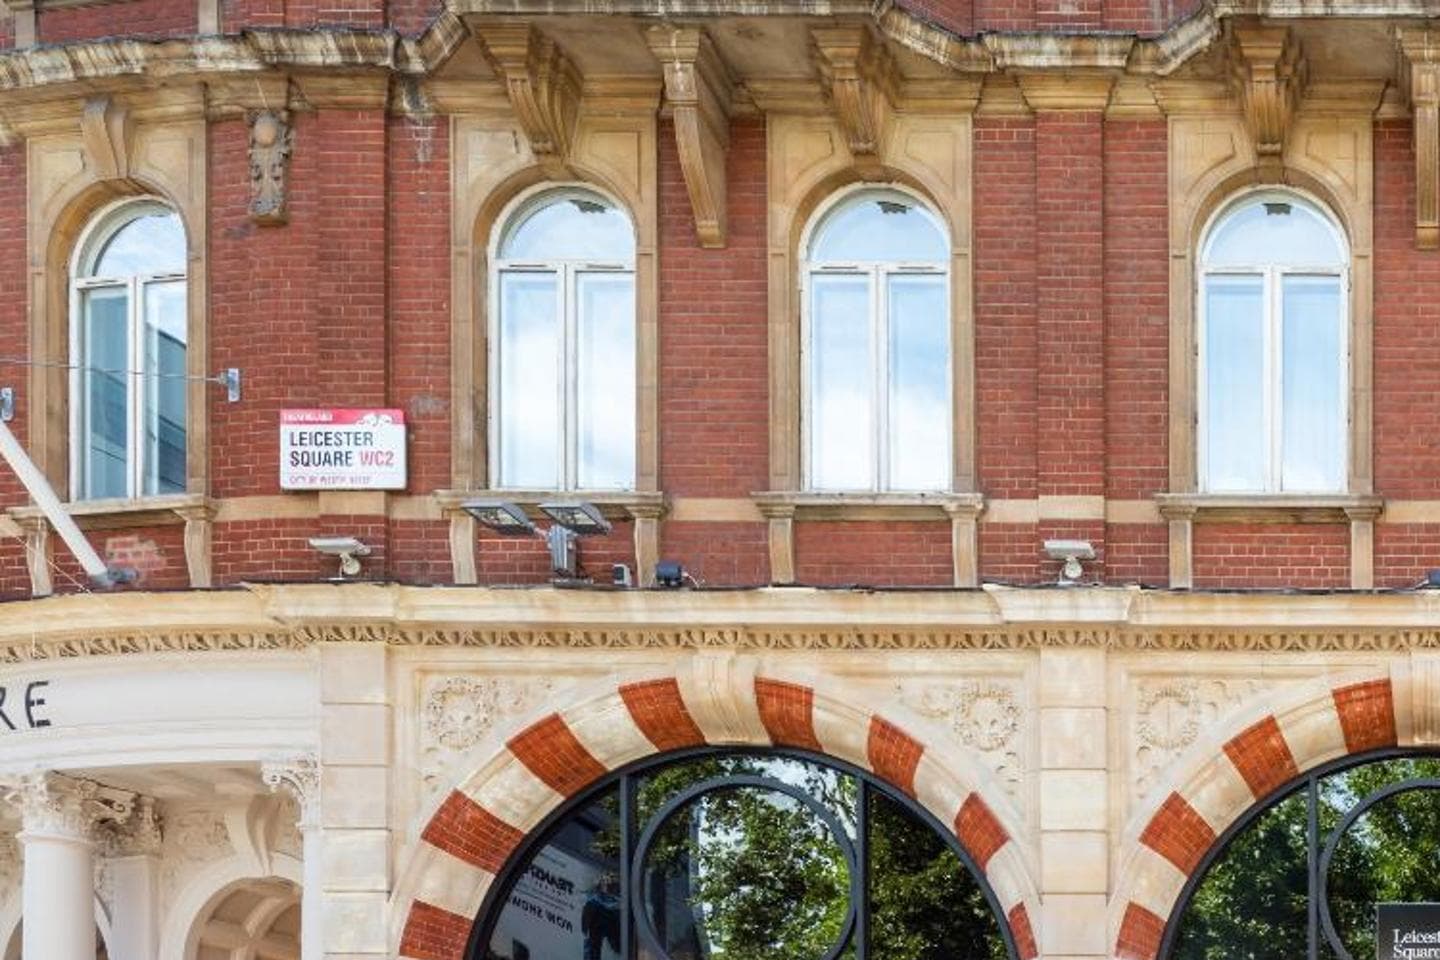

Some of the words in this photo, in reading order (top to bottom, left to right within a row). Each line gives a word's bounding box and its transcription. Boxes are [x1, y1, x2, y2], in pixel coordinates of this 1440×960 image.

[289, 431, 374, 447] LEICESTER
[289, 450, 353, 468] SQUARE
[360, 450, 395, 467] WC2
